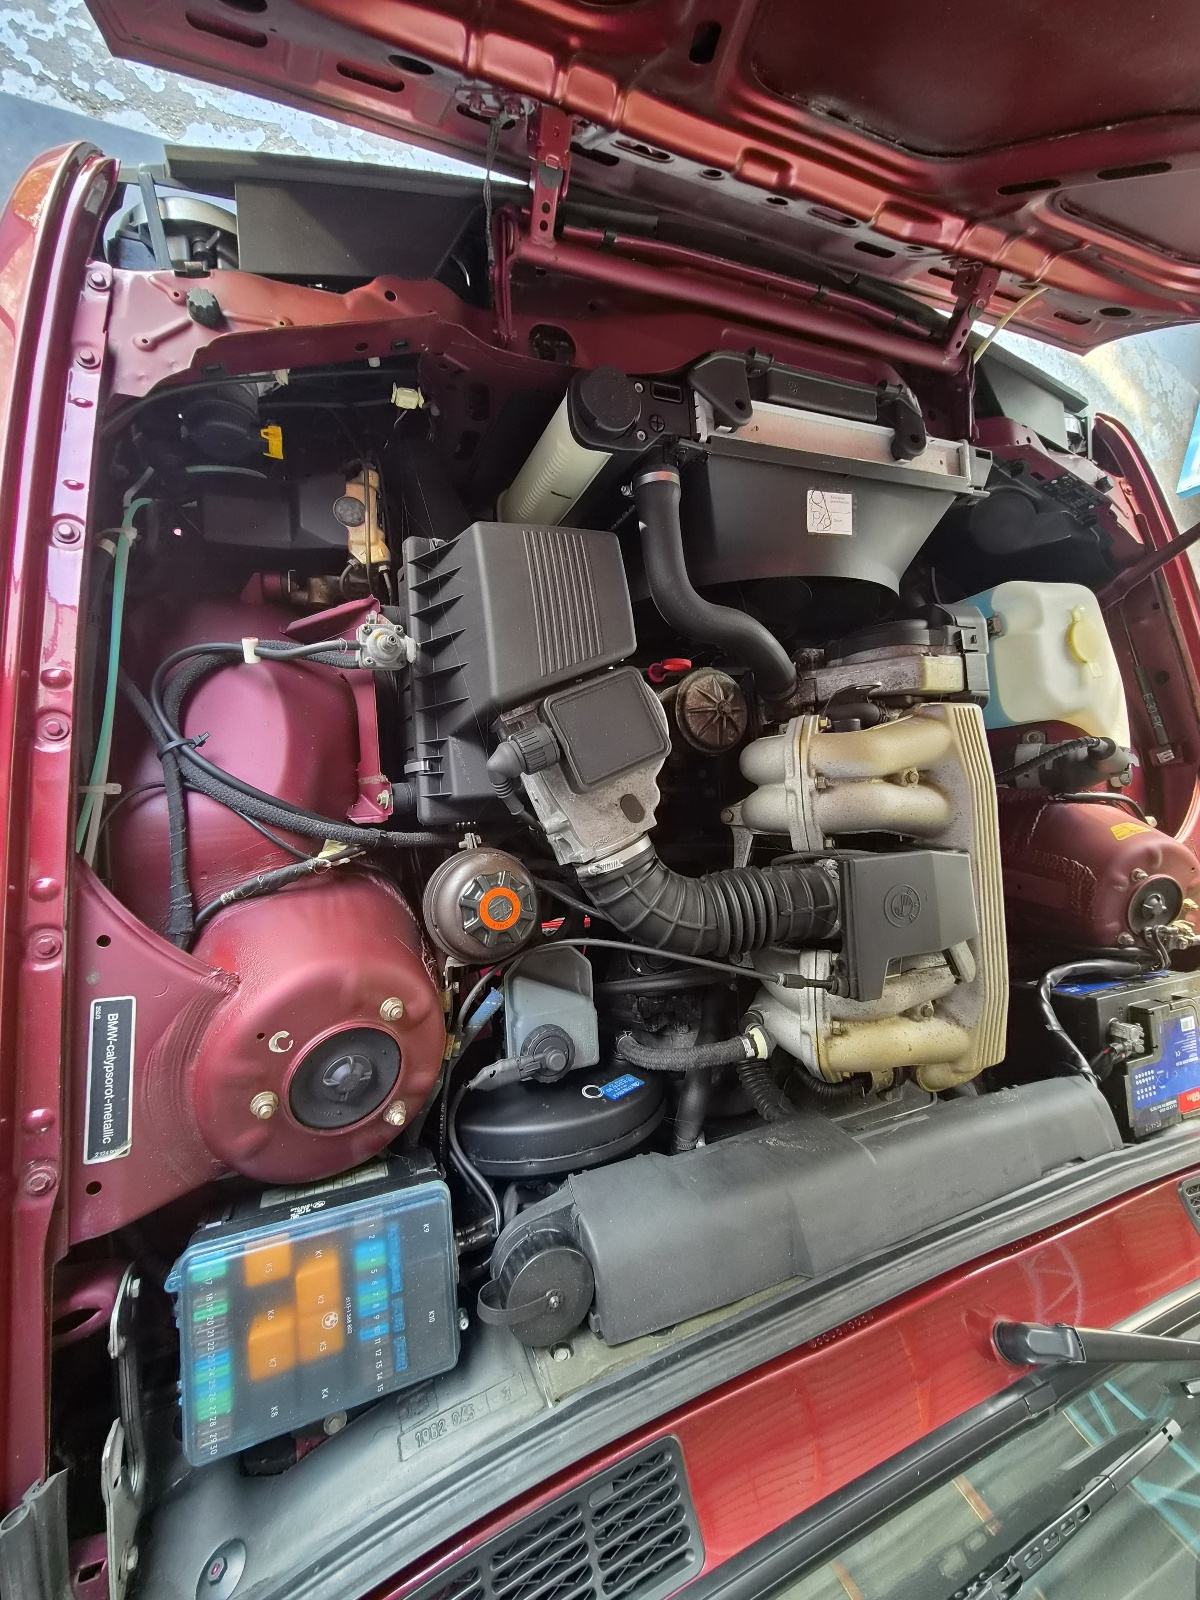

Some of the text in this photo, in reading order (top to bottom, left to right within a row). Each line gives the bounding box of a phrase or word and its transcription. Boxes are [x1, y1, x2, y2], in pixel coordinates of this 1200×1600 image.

[102, 1013, 119, 1144] BMW-calypsorot-metallic
[423, 1223, 430, 1233] K9
[267, 1309, 274, 1320] K6
[428, 1310, 436, 1323] K10
[206, 1315, 214, 1326] 20
[207, 1329, 214, 1337] 21
[208, 1342, 214, 1351] 22
[376, 1360, 382, 1369] 13
[376, 1372, 383, 1380] 14
[321, 1387, 328, 1398] K4
[377, 1384, 384, 1392] 15
[270, 1405, 279, 1418] K8
[210, 1416, 216, 1427] 28
[210, 1444, 218, 1455] 30
